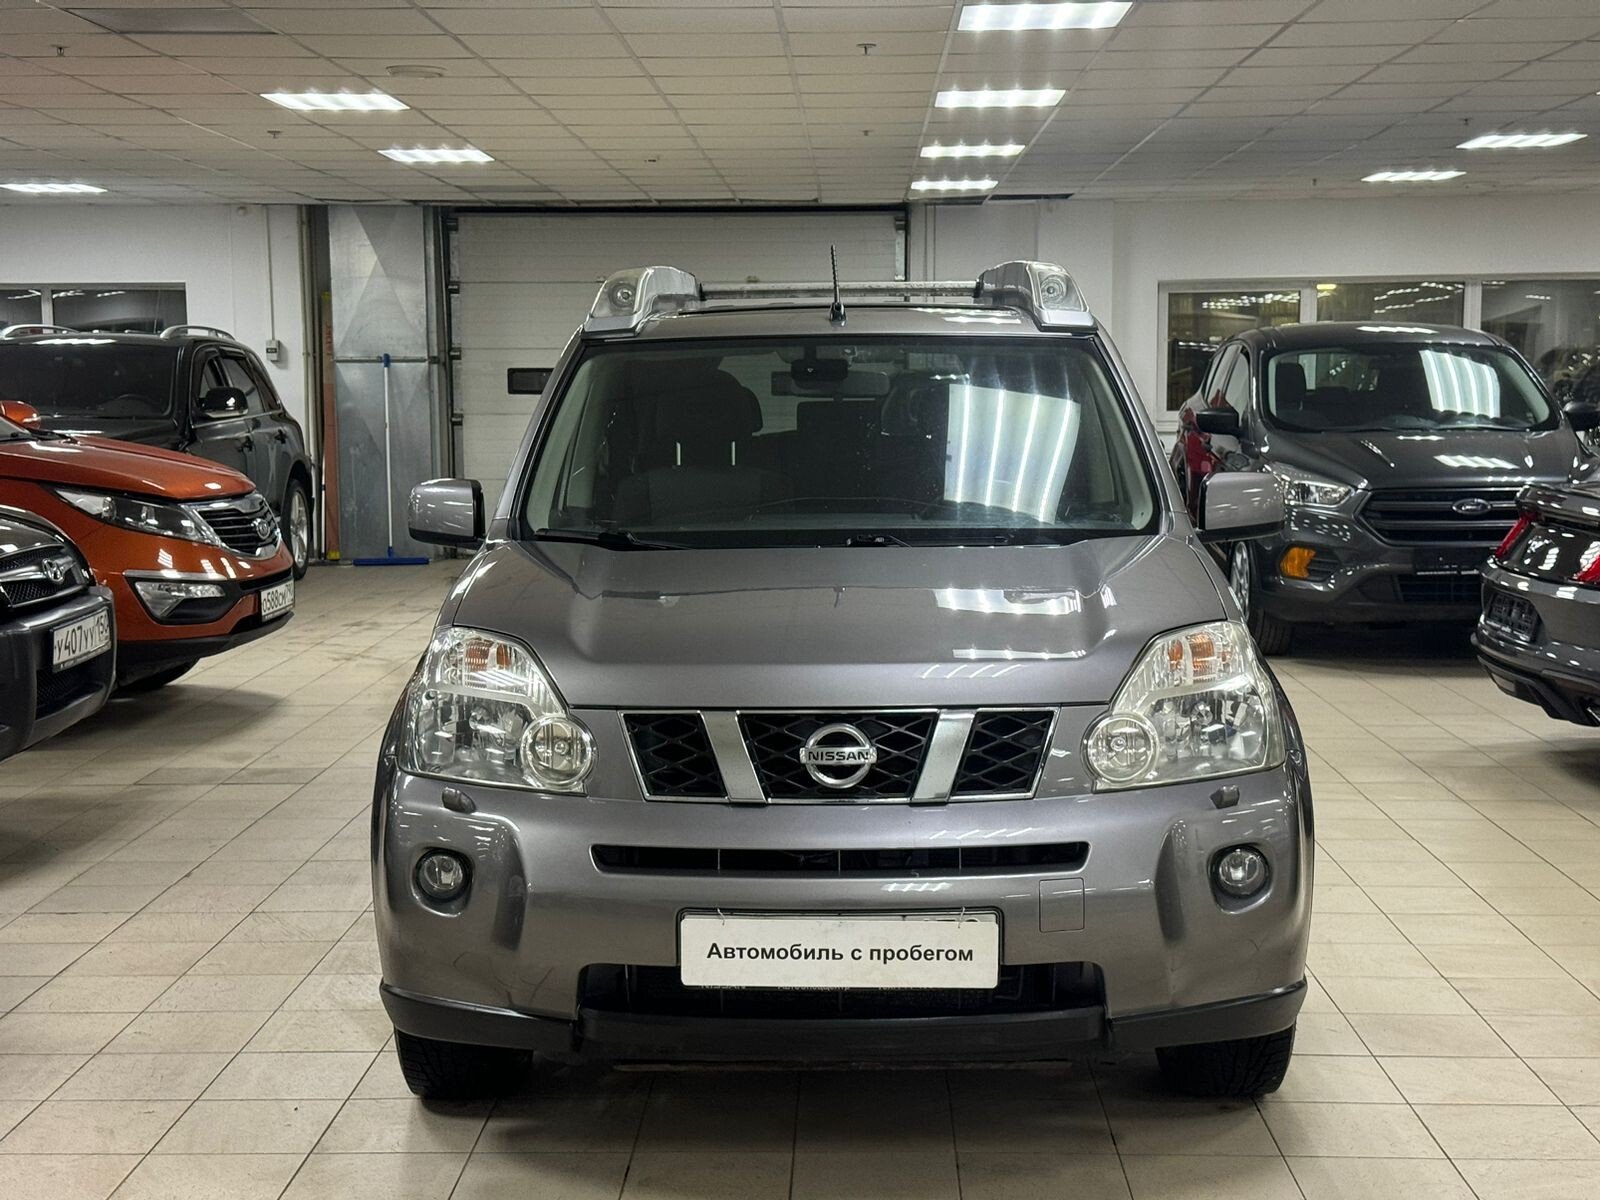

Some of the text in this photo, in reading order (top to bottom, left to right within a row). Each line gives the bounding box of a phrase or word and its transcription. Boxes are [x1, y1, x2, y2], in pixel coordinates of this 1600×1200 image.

[808, 751, 869, 761] NISSAN
[706, 942, 973, 965] Автомобиль с пробегом
